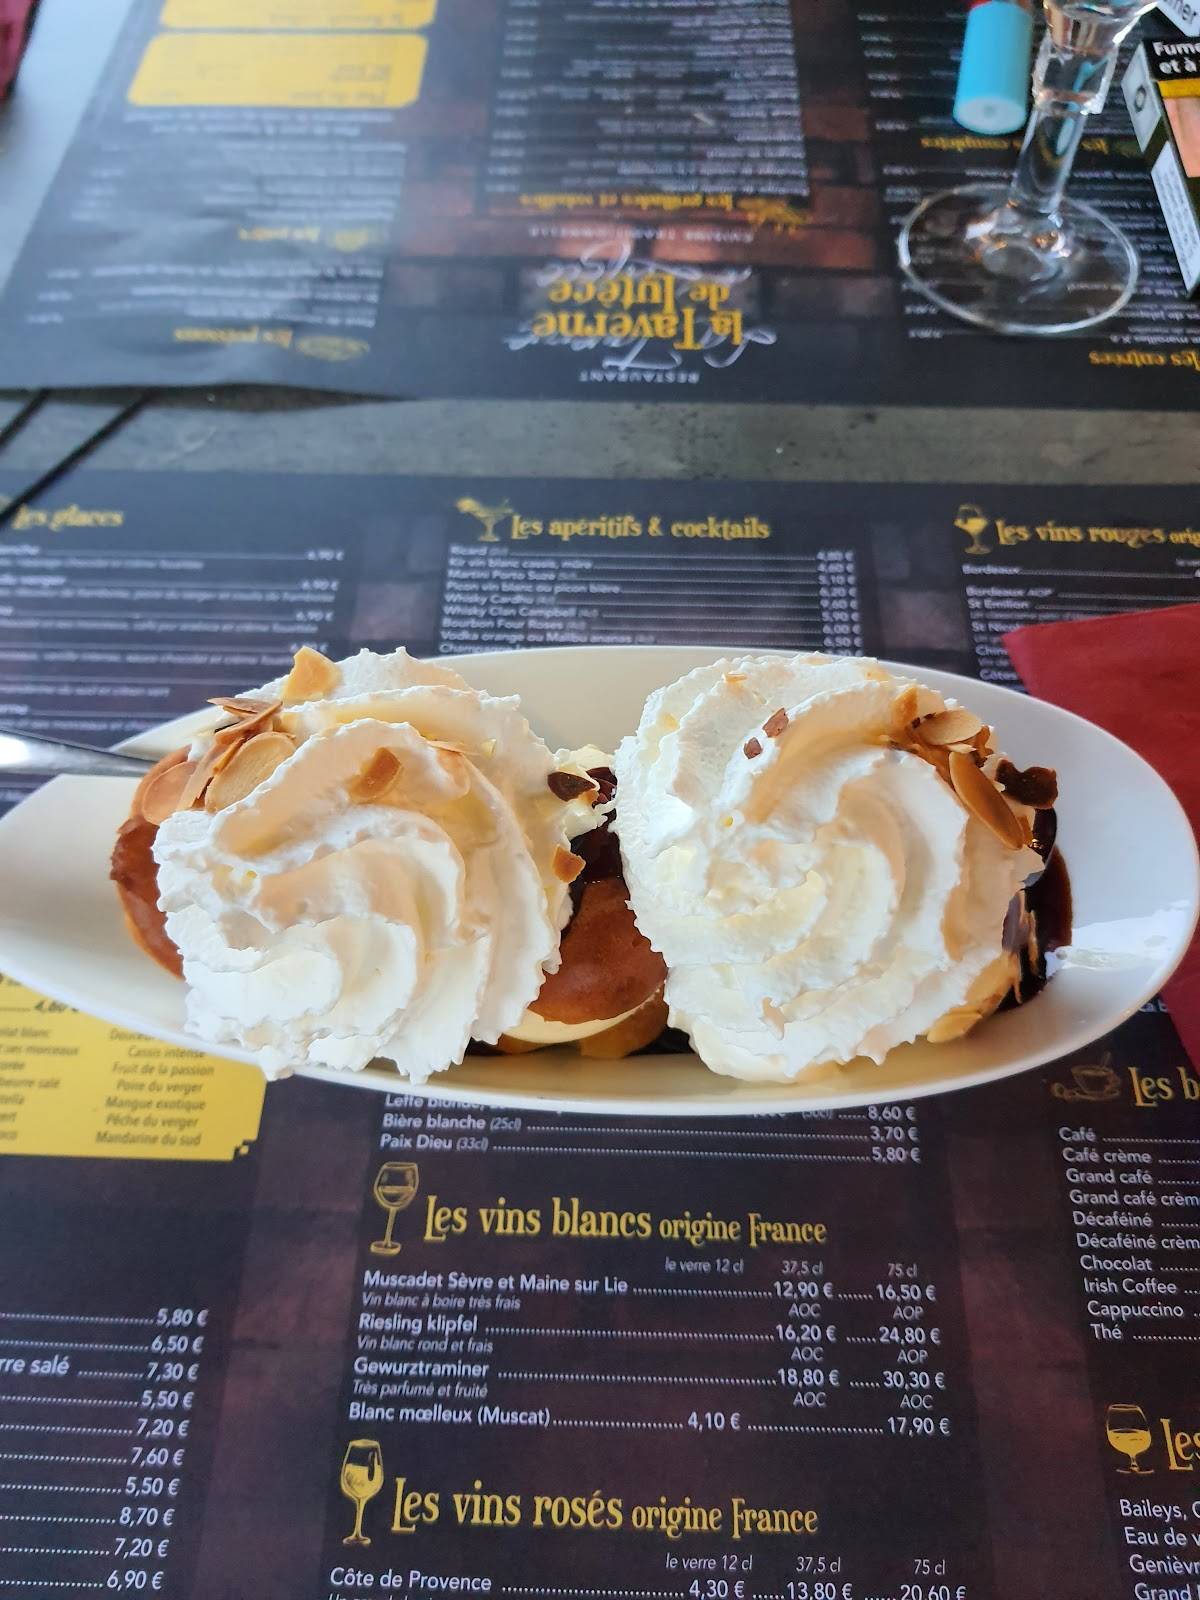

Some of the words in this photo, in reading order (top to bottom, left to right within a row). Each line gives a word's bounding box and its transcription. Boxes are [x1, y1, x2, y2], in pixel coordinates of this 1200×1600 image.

[1159, 59, 1181, 74] et
[532, 307, 704, 350] Taverne
[579, 370, 700, 384] RESTAURANT
[648, 517, 662, 536] &
[670, 517, 770, 541] cocktails
[1035, 520, 1083, 542] vins
[1088, 526, 1165, 548] rouges
[1128, 1066, 1174, 1107] Les
[383, 1112, 422, 1128] Bière
[426, 1113, 486, 1129] blanche
[490, 1117, 521, 1131] (25cl)
[868, 1106, 901, 1121] 8,60
[380, 1133, 412, 1149] Paix
[416, 1134, 452, 1149] Dieu
[456, 1137, 488, 1152] (33cl)
[870, 1126, 905, 1141] 3,70
[1059, 1126, 1096, 1143] Café
[872, 1147, 907, 1162] 5,80
[1063, 1148, 1099, 1163] Café
[1103, 1149, 1151, 1164] crème
[1066, 1168, 1115, 1184] Grand
[1119, 1170, 1153, 1185] café
[1070, 1188, 1120, 1205] Grand
[1124, 1191, 1156, 1206] café
[423, 1195, 467, 1242] Les
[479, 1197, 541, 1234] vins
[552, 1197, 652, 1239] blancs
[659, 1210, 741, 1247] origine
[748, 1212, 828, 1248] France
[1073, 1210, 1153, 1228] Décaféiné
[1076, 1232, 1156, 1250] Décaféiné
[664, 1256, 676, 1271] le
[679, 1260, 711, 1273] verre
[715, 1258, 729, 1273] 12
[733, 1258, 744, 1274] cl
[812, 1260, 824, 1275] cl
[887, 1263, 903, 1277] 75
[906, 1264, 917, 1278] cl
[1080, 1254, 1152, 1271] Chocolat
[363, 1270, 443, 1288] Muscadet
[448, 1272, 494, 1290] Sèvre
[498, 1275, 515, 1289] et
[519, 1274, 570, 1291] Maine
[574, 1280, 599, 1292] sur
[604, 1276, 628, 1293] Lie
[773, 1281, 819, 1301] 12,90
[1084, 1278, 1118, 1294] Irish
[1122, 1278, 1177, 1296] Coffee
[362, 1292, 383, 1306] Vin
[385, 1292, 418, 1307] blanc
[421, 1294, 429, 1307] à
[433, 1294, 465, 1308] boire
[468, 1296, 491, 1309] très
[494, 1295, 520, 1310] frais
[876, 1284, 921, 1303] 16,50
[156, 1308, 193, 1327] 5,80
[788, 1303, 822, 1317] AOC
[893, 1305, 924, 1320] AOP
[1087, 1300, 1184, 1321] Cappuccino
[359, 1313, 422, 1335] Riesling
[427, 1314, 478, 1336] klipfel
[776, 1324, 822, 1344] 16,20
[1090, 1323, 1122, 1341] Thé
[151, 1335, 188, 1355] 6,50
[357, 1335, 377, 1349] Vin
[380, 1336, 415, 1350] blanc
[418, 1337, 447, 1351] rond
[451, 1339, 464, 1352] et
[467, 1339, 494, 1353] frais
[879, 1326, 926, 1345] 24,80
[790, 1346, 824, 1361] AOC
[897, 1349, 928, 1364] AOP
[30, 1354, 70, 1375] salé
[147, 1362, 183, 1382] 7,30
[353, 1356, 489, 1378] Gewurztraminer
[777, 1368, 824, 1387] 18,80
[883, 1370, 930, 1390] 30,30
[352, 1380, 377, 1395] Très
[379, 1381, 435, 1400] parfumé
[437, 1384, 451, 1397] et
[454, 1383, 488, 1399] fruité
[793, 1391, 826, 1407] AOC
[141, 1390, 178, 1410] 5,50
[900, 1394, 933, 1409] AOC
[349, 1402, 394, 1421] Blanc
[399, 1403, 472, 1423] mœlleux
[477, 1406, 550, 1429] (Muscat)
[688, 1411, 725, 1432] 4,10
[137, 1418, 173, 1438] 7,20
[887, 1417, 934, 1438] 17,90
[131, 1447, 168, 1467] 7,60
[125, 1477, 163, 1497] 5,50
[119, 1507, 158, 1527] 8,70
[391, 1476, 440, 1533] Les
[452, 1479, 520, 1526] vins
[533, 1489, 623, 1529] rosés
[631, 1496, 722, 1540] origine
[731, 1497, 818, 1540] France
[1119, 1498, 1187, 1523] Baileys,
[1124, 1526, 1159, 1546] Eau
[1163, 1526, 1187, 1547] de
[114, 1537, 152, 1559] 7,20
[665, 1552, 678, 1568] le
[682, 1556, 717, 1570] verre
[721, 1554, 738, 1570] 12
[741, 1555, 753, 1570] cl
[796, 1555, 826, 1574] 37,5
[830, 1557, 841, 1572] cl
[914, 1559, 931, 1575] 75
[934, 1560, 945, 1576] cl
[107, 1570, 147, 1592] 6,90
[330, 1567, 374, 1586] Côte
[380, 1568, 402, 1588] de
[409, 1570, 492, 1591] Provence
[688, 1579, 729, 1600] 4,30
[786, 1581, 838, 1600] 13,80
[900, 1584, 951, 1600] 20,60
[1134, 1582, 1192, 1600] Grand
